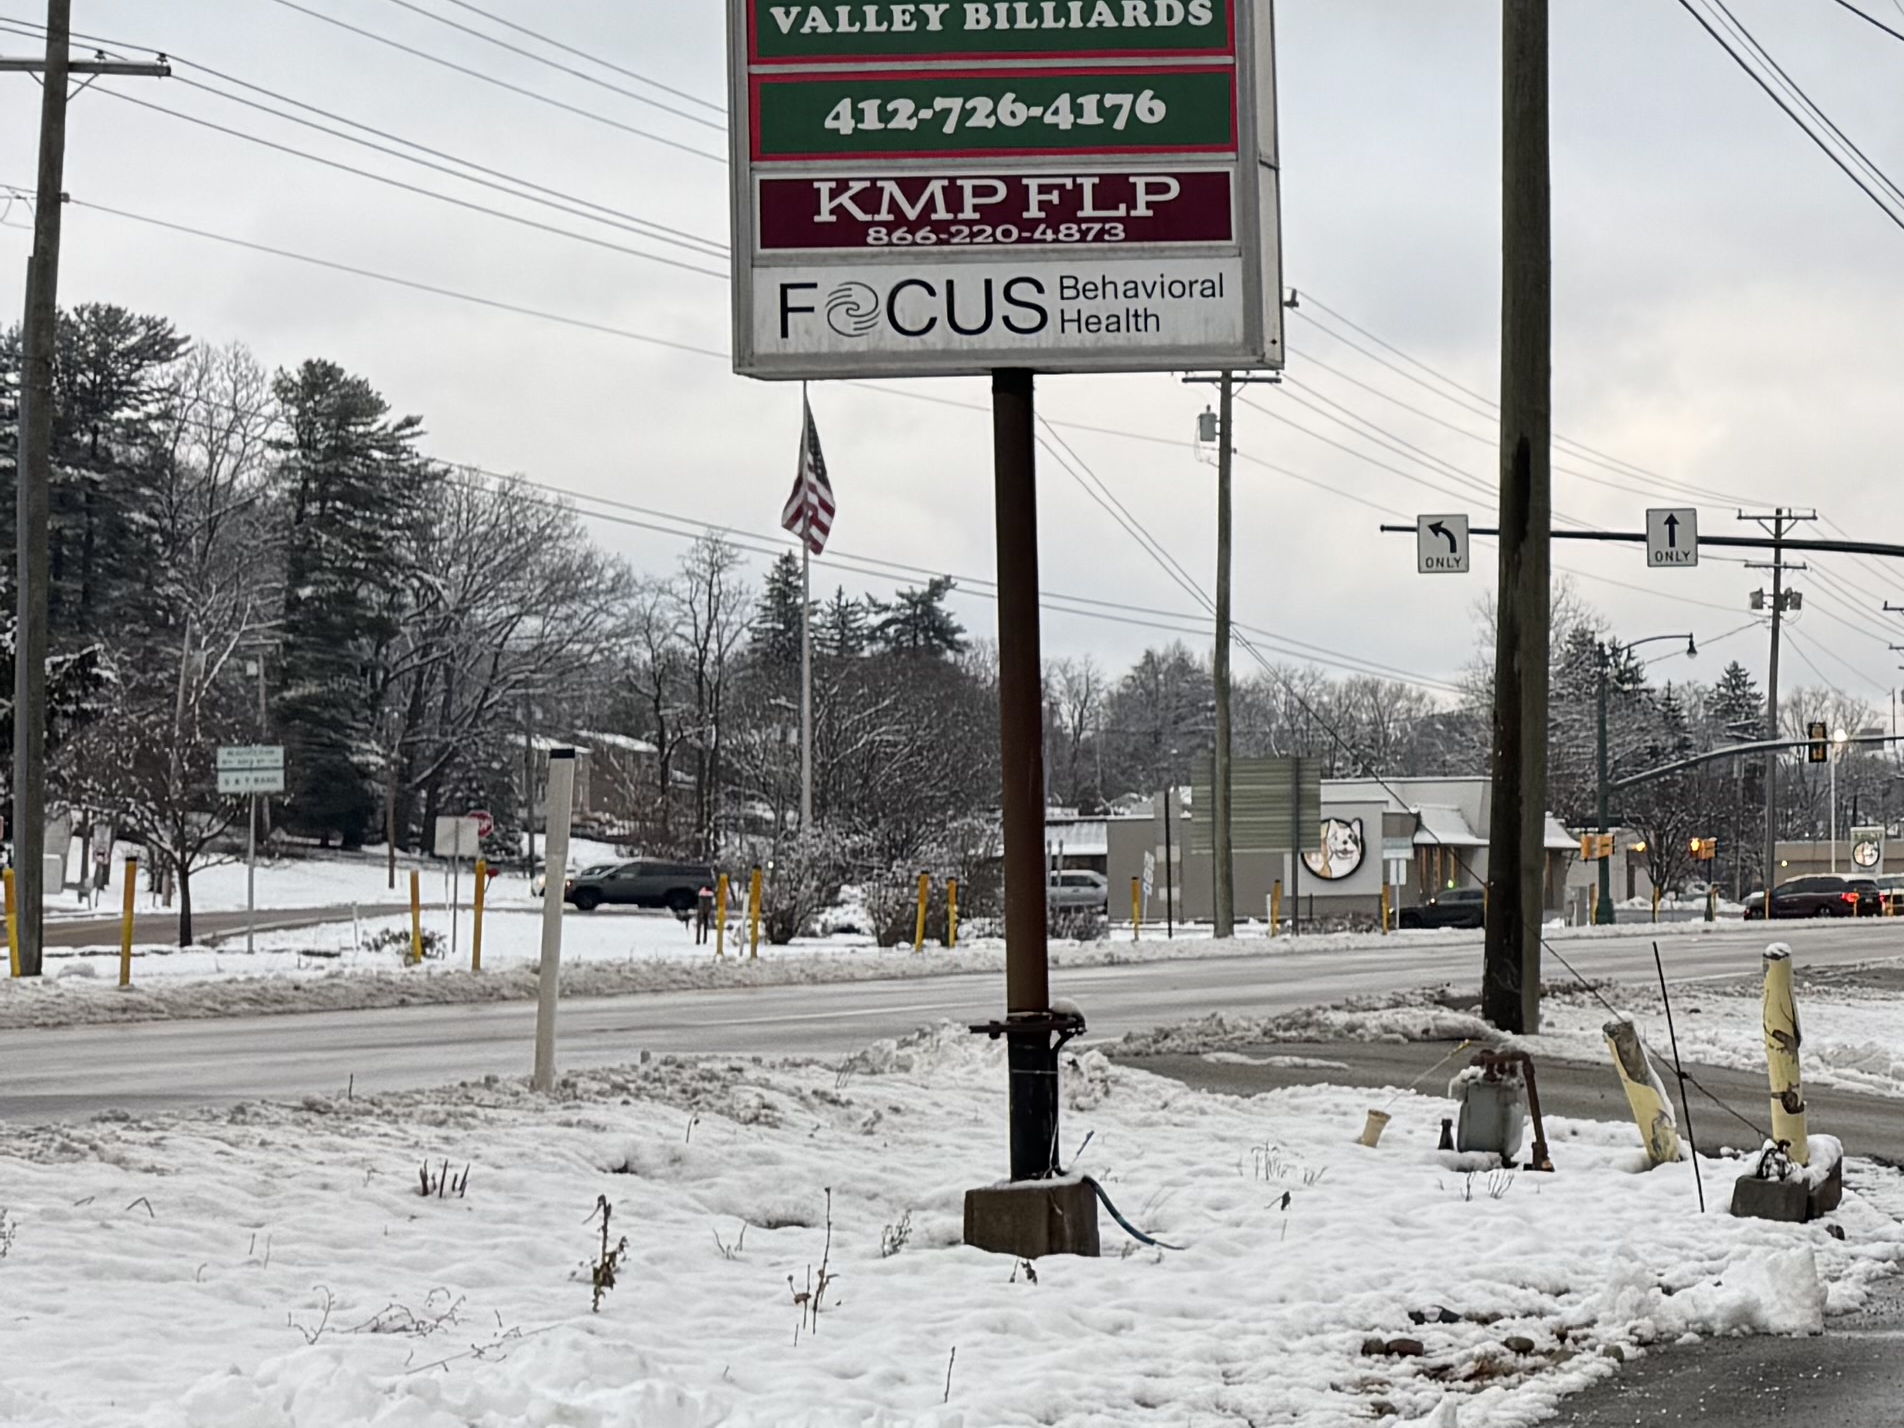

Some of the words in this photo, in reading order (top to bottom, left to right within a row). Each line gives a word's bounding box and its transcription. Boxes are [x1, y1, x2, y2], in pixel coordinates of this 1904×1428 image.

[769, 4, 950, 35] VALLEY
[823, 89, 1167, 136] 412-726-4176
[812, 179, 1008, 224] KMP
[1022, 175, 1181, 219] FLP
[865, 222, 1126, 245] 866-220-4873
[1059, 271, 1225, 301] Behavioral
[1059, 307, 1161, 335] Health
[1425, 557, 1462, 569] ONLY
[1655, 550, 1691, 562] ONLY
